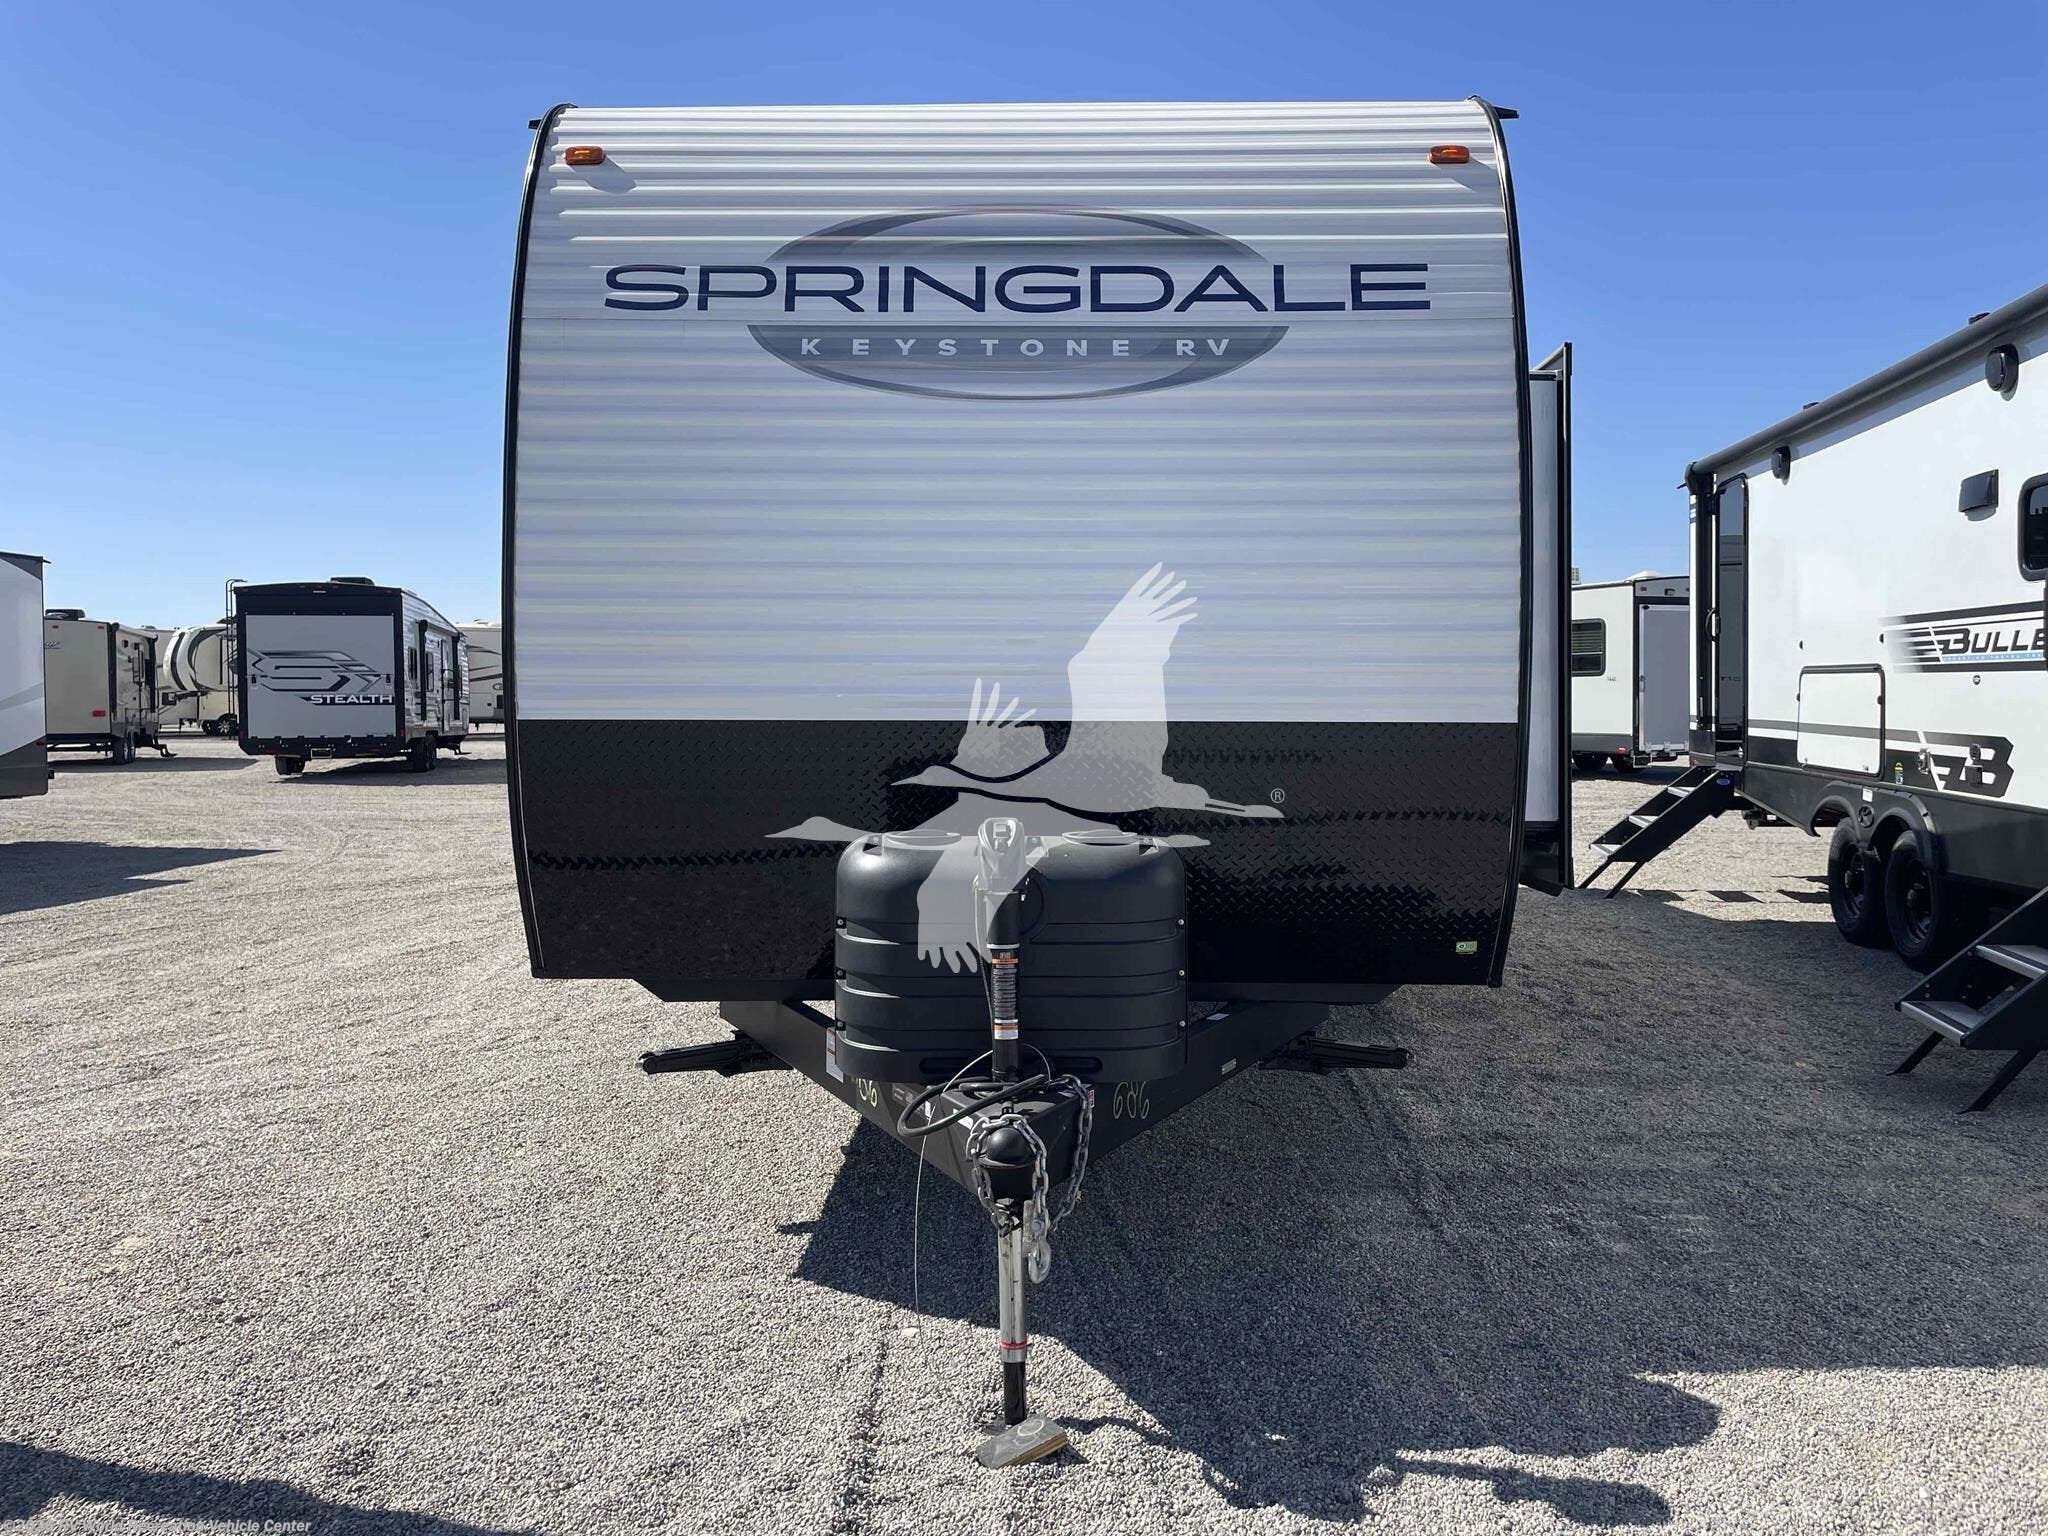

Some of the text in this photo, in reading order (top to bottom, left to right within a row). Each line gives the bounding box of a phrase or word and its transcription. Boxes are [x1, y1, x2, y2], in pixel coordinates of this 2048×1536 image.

[604, 264, 1431, 313] SPRINGDALE
[801, 338, 1230, 357] KEYSTONE RV
[310, 693, 393, 704] STEALTH
